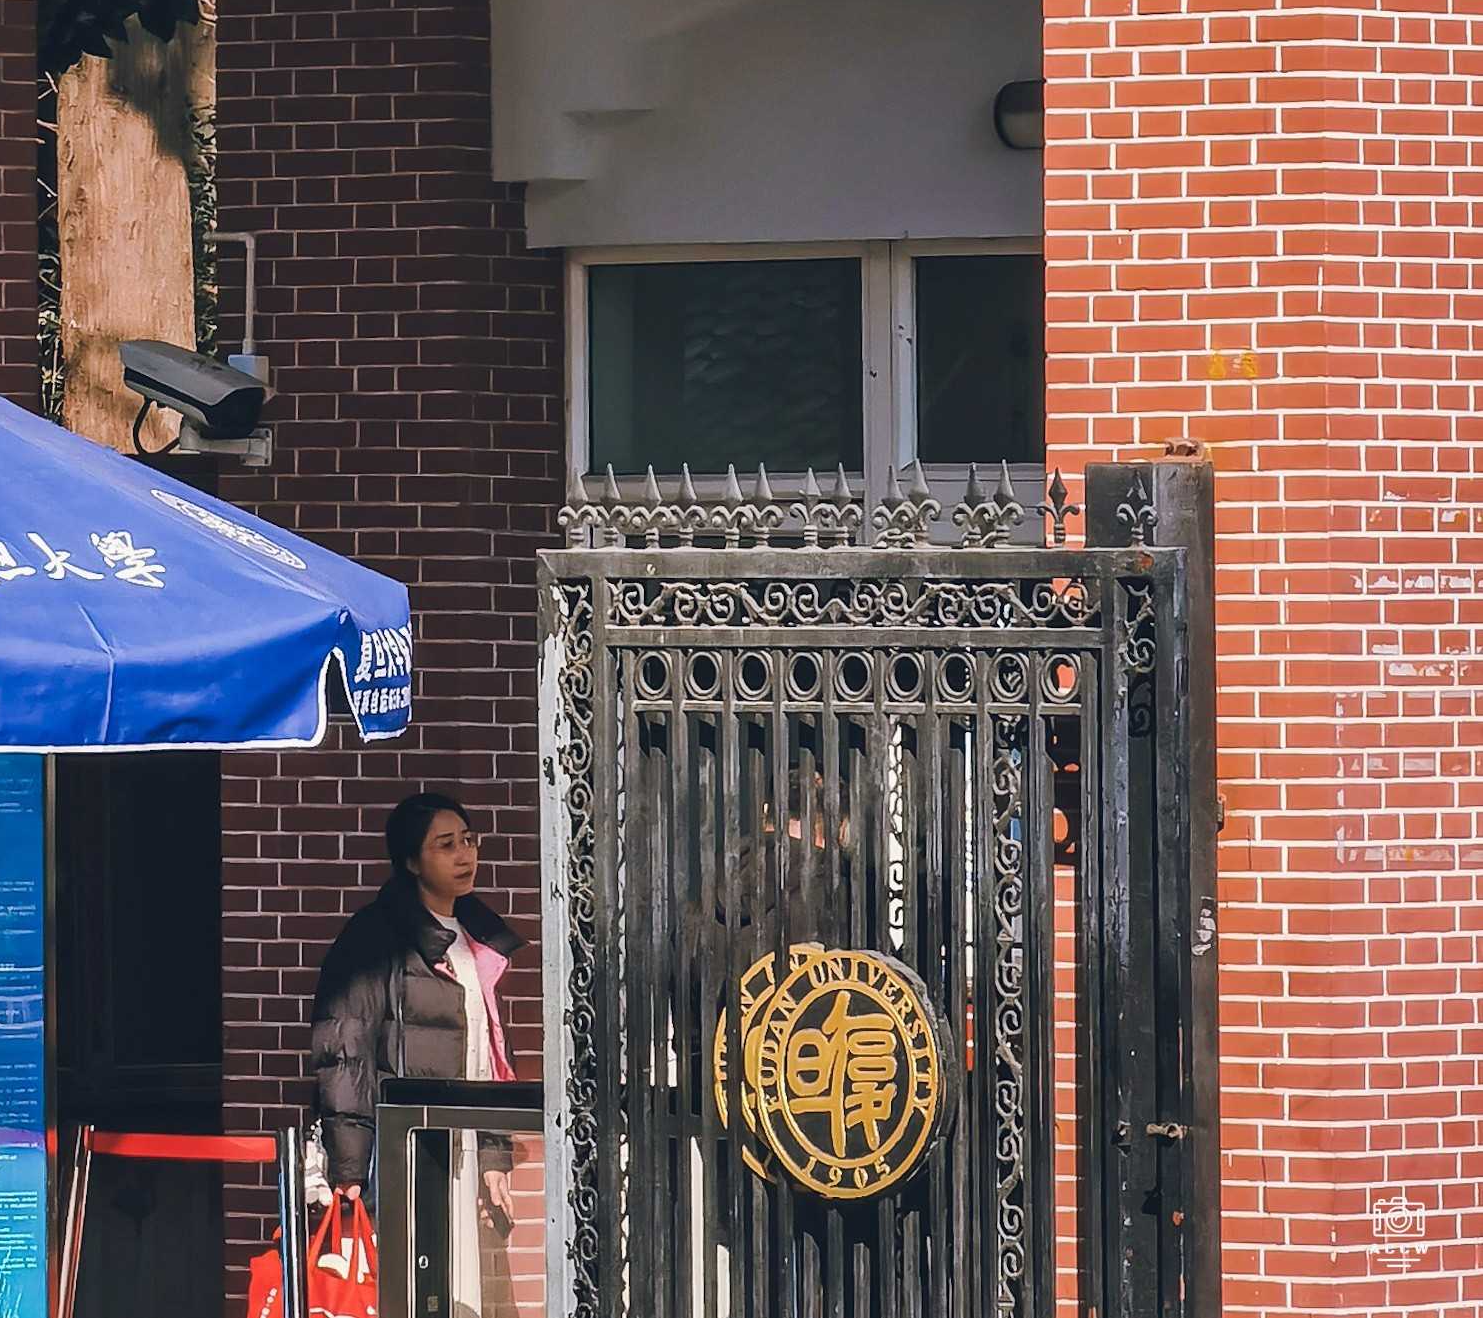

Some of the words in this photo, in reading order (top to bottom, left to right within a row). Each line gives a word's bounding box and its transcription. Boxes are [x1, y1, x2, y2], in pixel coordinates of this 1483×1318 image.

[759, 993, 801, 1113] FUDAN
[809, 957, 933, 1115] UNIVERSITY
[801, 1156, 892, 1188] 1905
